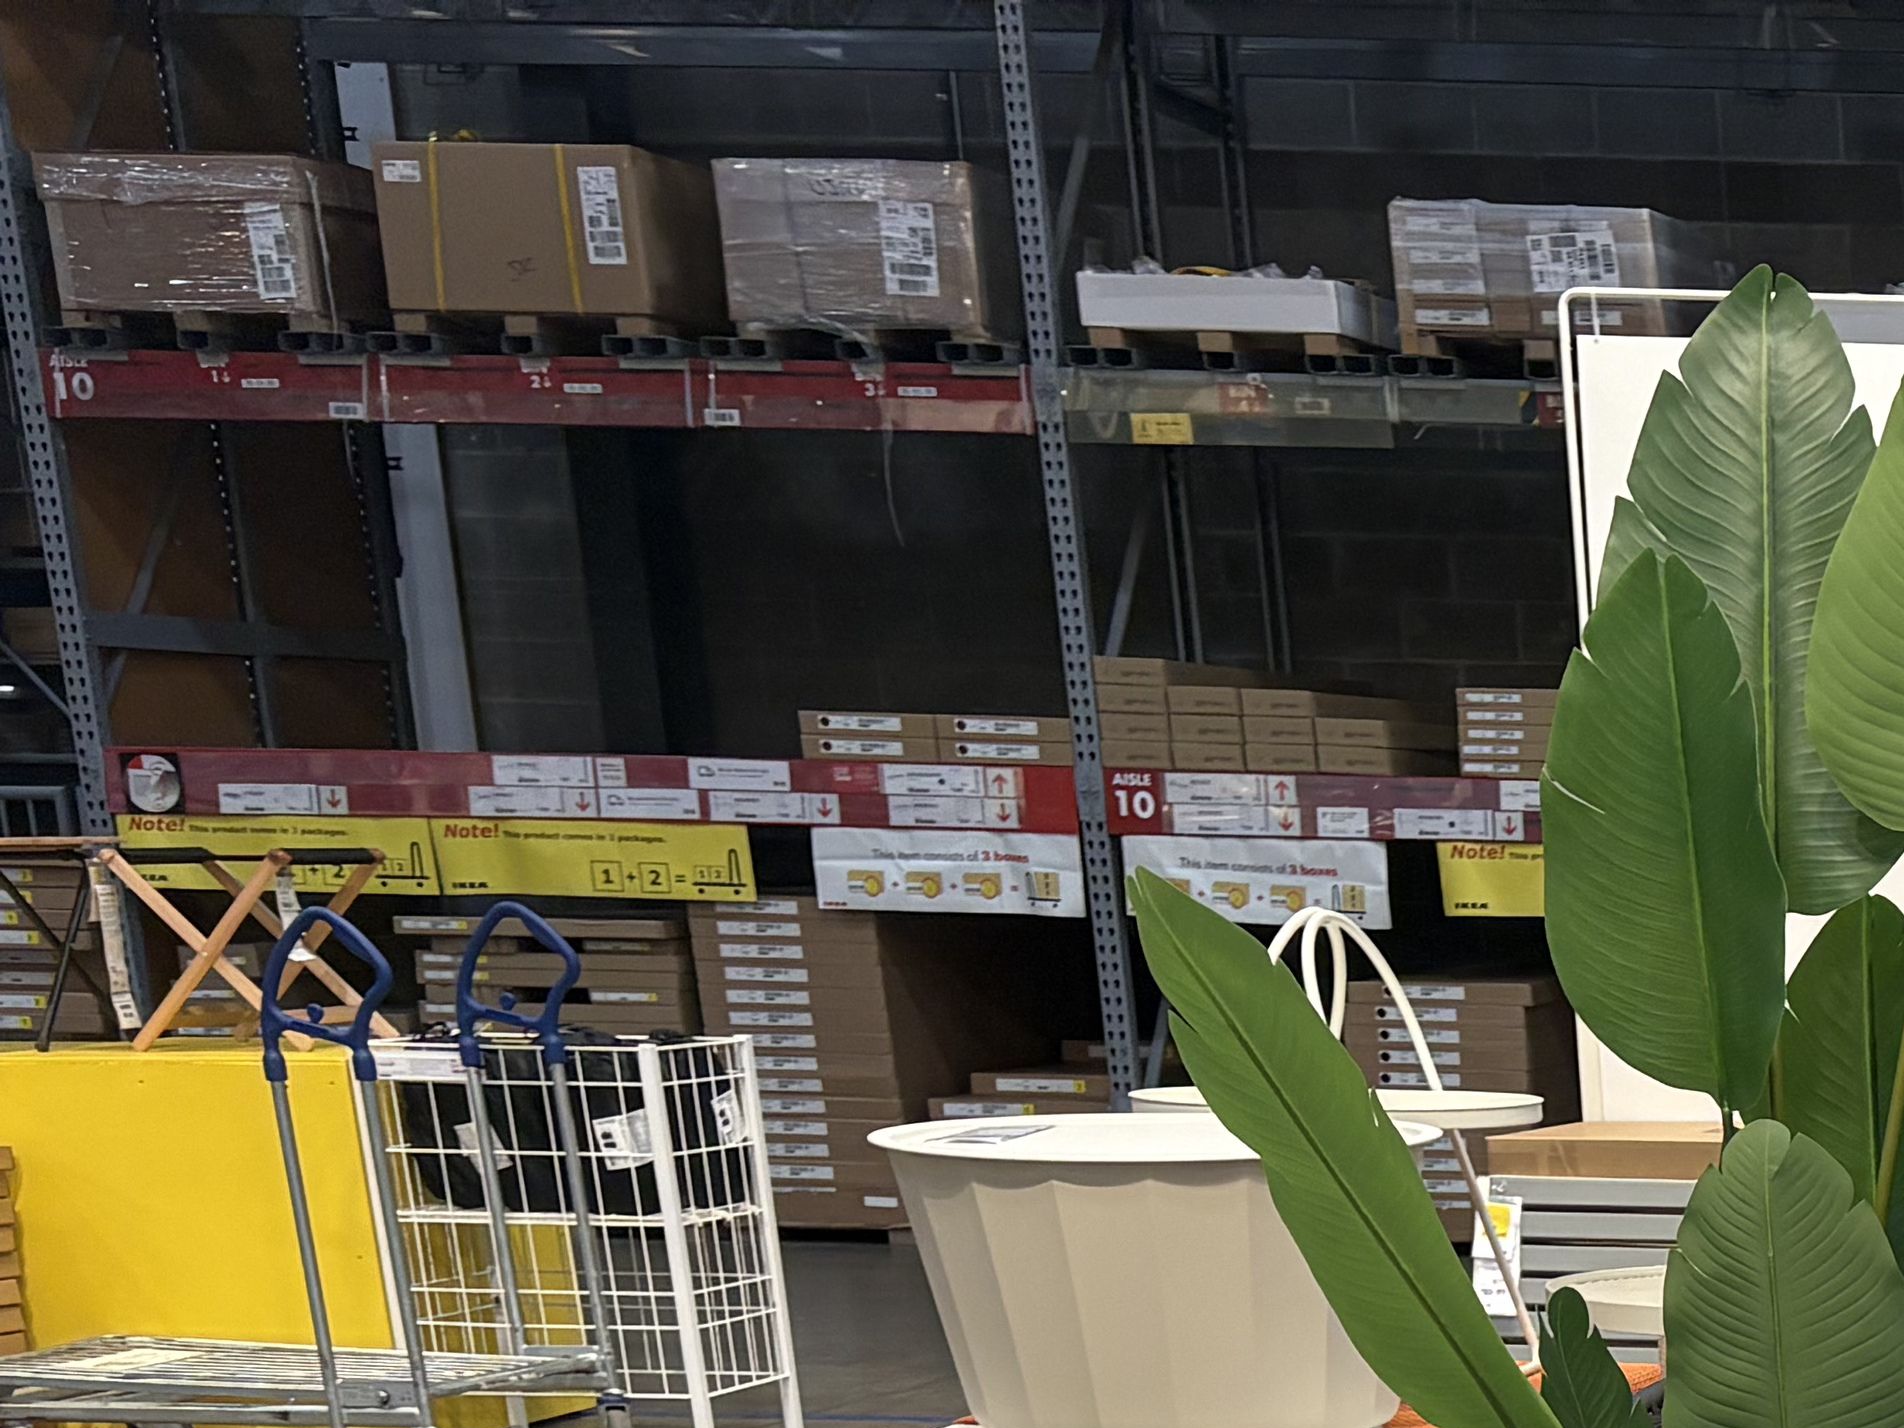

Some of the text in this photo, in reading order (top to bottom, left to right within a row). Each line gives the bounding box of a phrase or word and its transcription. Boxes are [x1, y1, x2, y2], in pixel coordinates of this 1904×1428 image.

[53, 371, 95, 401] 10
[1112, 772, 1152, 786] AISLE
[1114, 790, 1156, 820] 10
[128, 816, 187, 833] Note!
[443, 823, 500, 839] Note!
[993, 850, 1030, 864] boxes
[1450, 844, 1506, 860] Note!
[602, 868, 614, 884] 1
[648, 869, 663, 886] 2
[1299, 864, 1339, 877] boxes
[1454, 901, 1489, 910] IKEA
